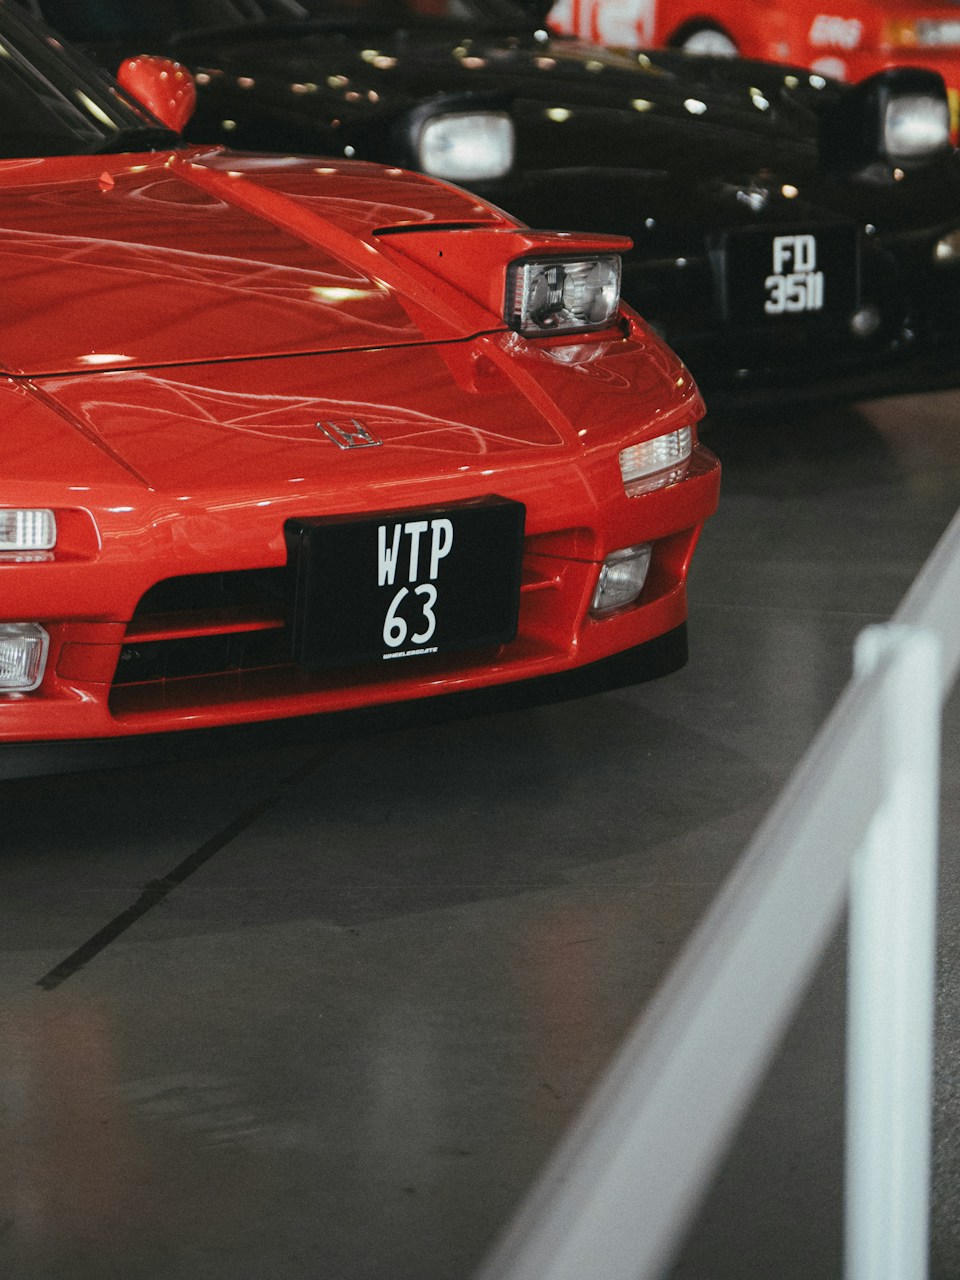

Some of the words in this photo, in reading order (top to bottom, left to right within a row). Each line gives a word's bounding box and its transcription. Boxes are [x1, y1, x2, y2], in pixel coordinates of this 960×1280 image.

[773, 234, 816, 274] FD
[765, 271, 824, 314] 3511
[378, 518, 453, 586] WTP
[383, 583, 437, 647] 63
